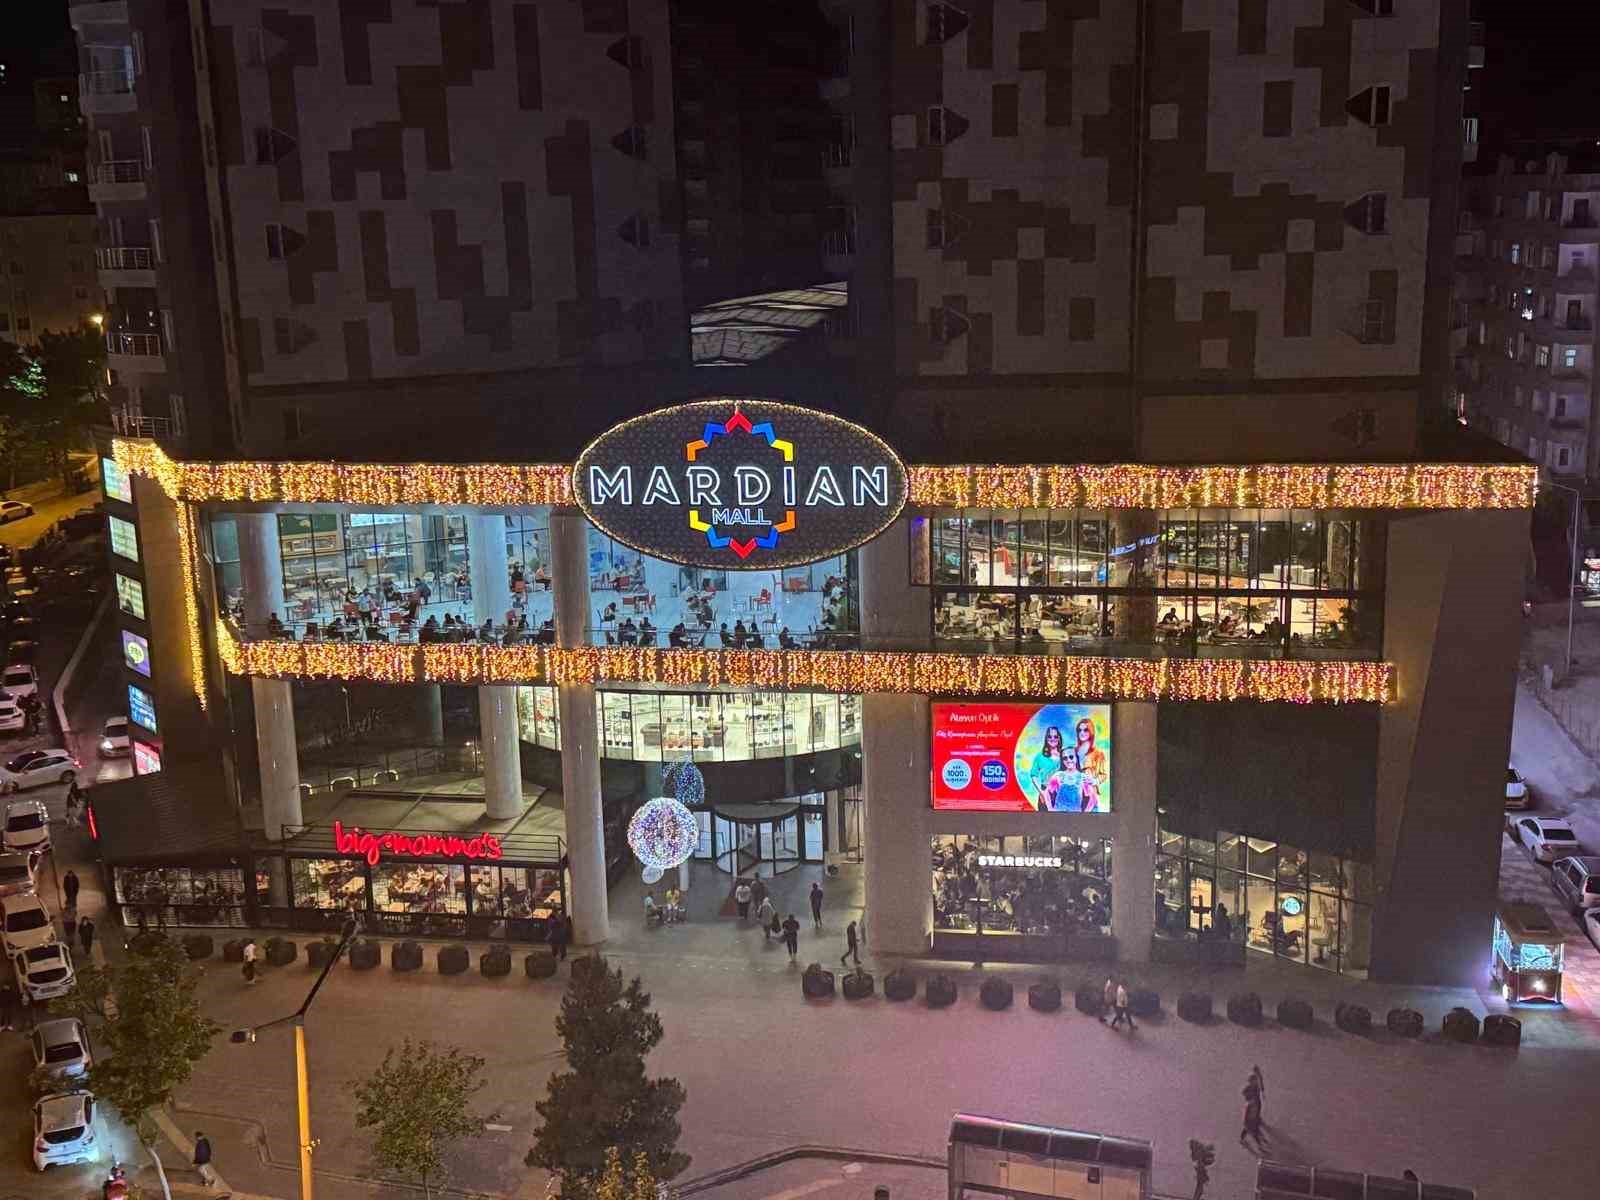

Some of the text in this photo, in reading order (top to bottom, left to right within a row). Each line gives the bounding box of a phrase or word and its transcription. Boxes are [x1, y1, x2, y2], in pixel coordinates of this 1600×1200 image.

[589, 466, 888, 506] MARDIAN
[712, 508, 771, 525] MALL
[978, 855, 1062, 867] STARBUCKS
